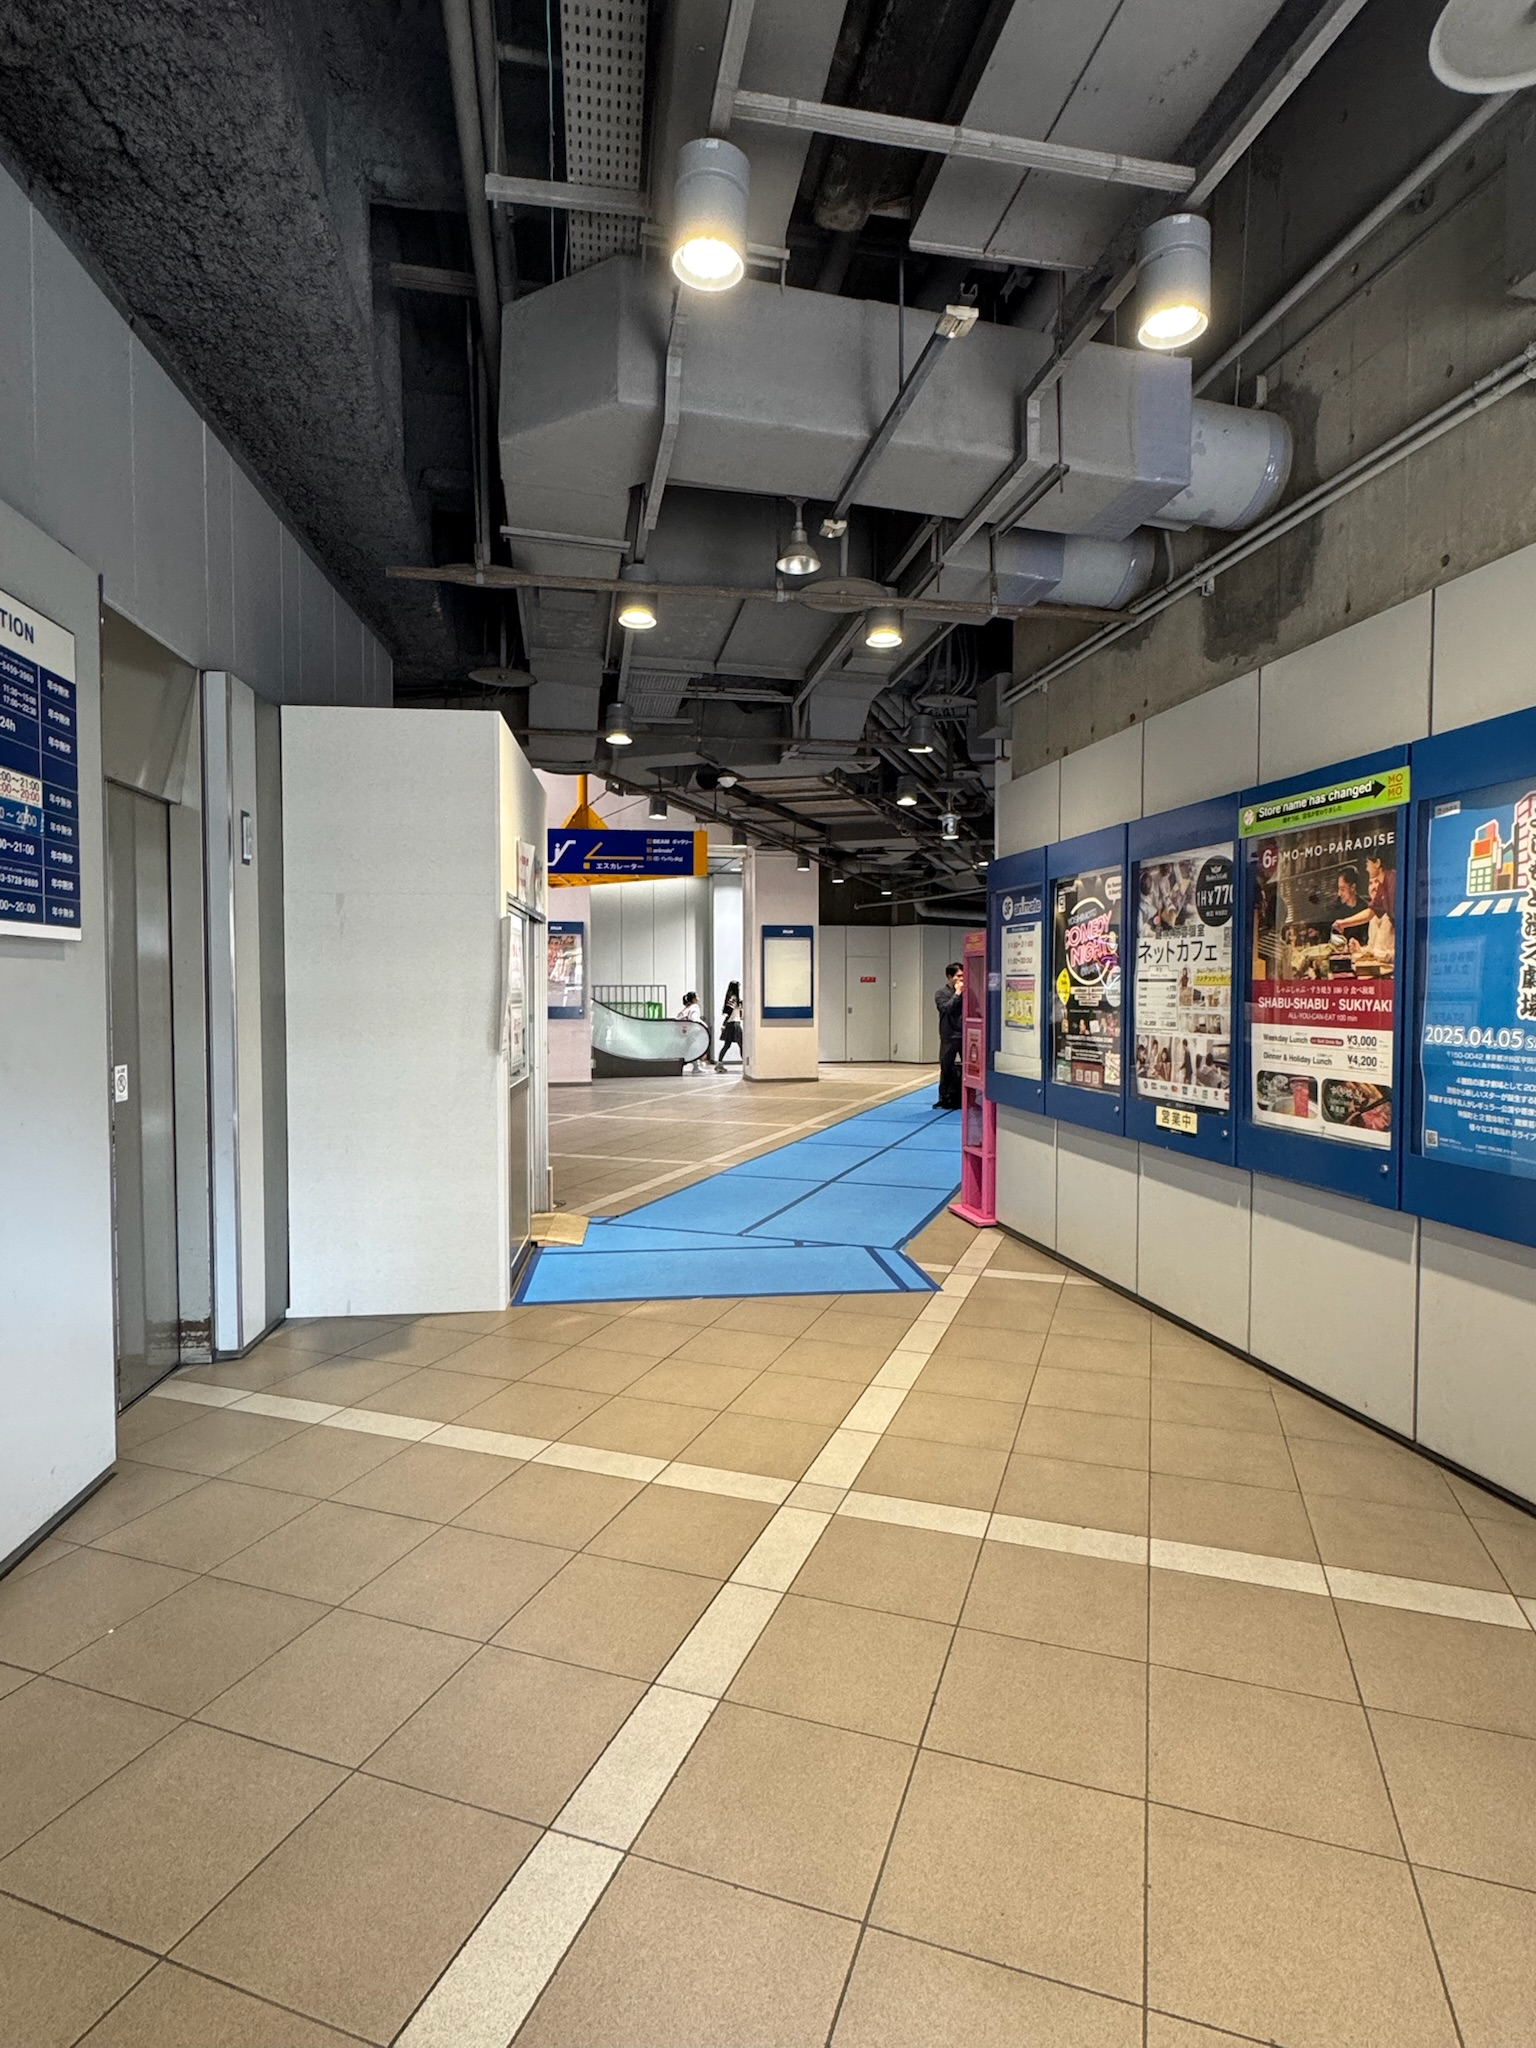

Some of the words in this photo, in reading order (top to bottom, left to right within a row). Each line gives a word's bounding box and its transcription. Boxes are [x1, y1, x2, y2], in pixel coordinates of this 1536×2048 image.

[0, 715, 16, 732] 24h
[1388, 773, 1403, 785] MO
[1259, 806, 1281, 819] Store
[1283, 798, 1307, 814] name
[1309, 792, 1326, 806] has
[1328, 780, 1373, 801] changed
[1387, 786, 1403, 798] MO
[1282, 832, 1395, 862] MO-MO-PARADISE
[596, 862, 644, 870] エスカレーター
[1262, 848, 1278, 869] 6F
[1014, 896, 1042, 917] animate
[1065, 910, 1112, 950] COMEDY
[1138, 940, 1217, 964] ネットカフェ
[1258, 997, 1329, 1010] SHABU-SHABU
[1338, 999, 1392, 1012] SUKIYAKI
[1288, 1012, 1336, 1022] ALL-YOU-CAN-EAT
[1336, 1014, 1347, 1022] 100
[1263, 1033, 1288, 1045] Weekday
[1289, 1035, 1308, 1045] Lunch
[1347, 1035, 1377, 1048] ¥3,000
[1425, 1026, 1523, 1048] 2025.04.05
[1263, 1052, 1282, 1061] Dinner
[1289, 1053, 1311, 1065] Holiday
[1313, 1056, 1332, 1066] Lunch
[1347, 1055, 1377, 1068] ¥4,200
[1161, 1109, 1191, 1128] 営業中
